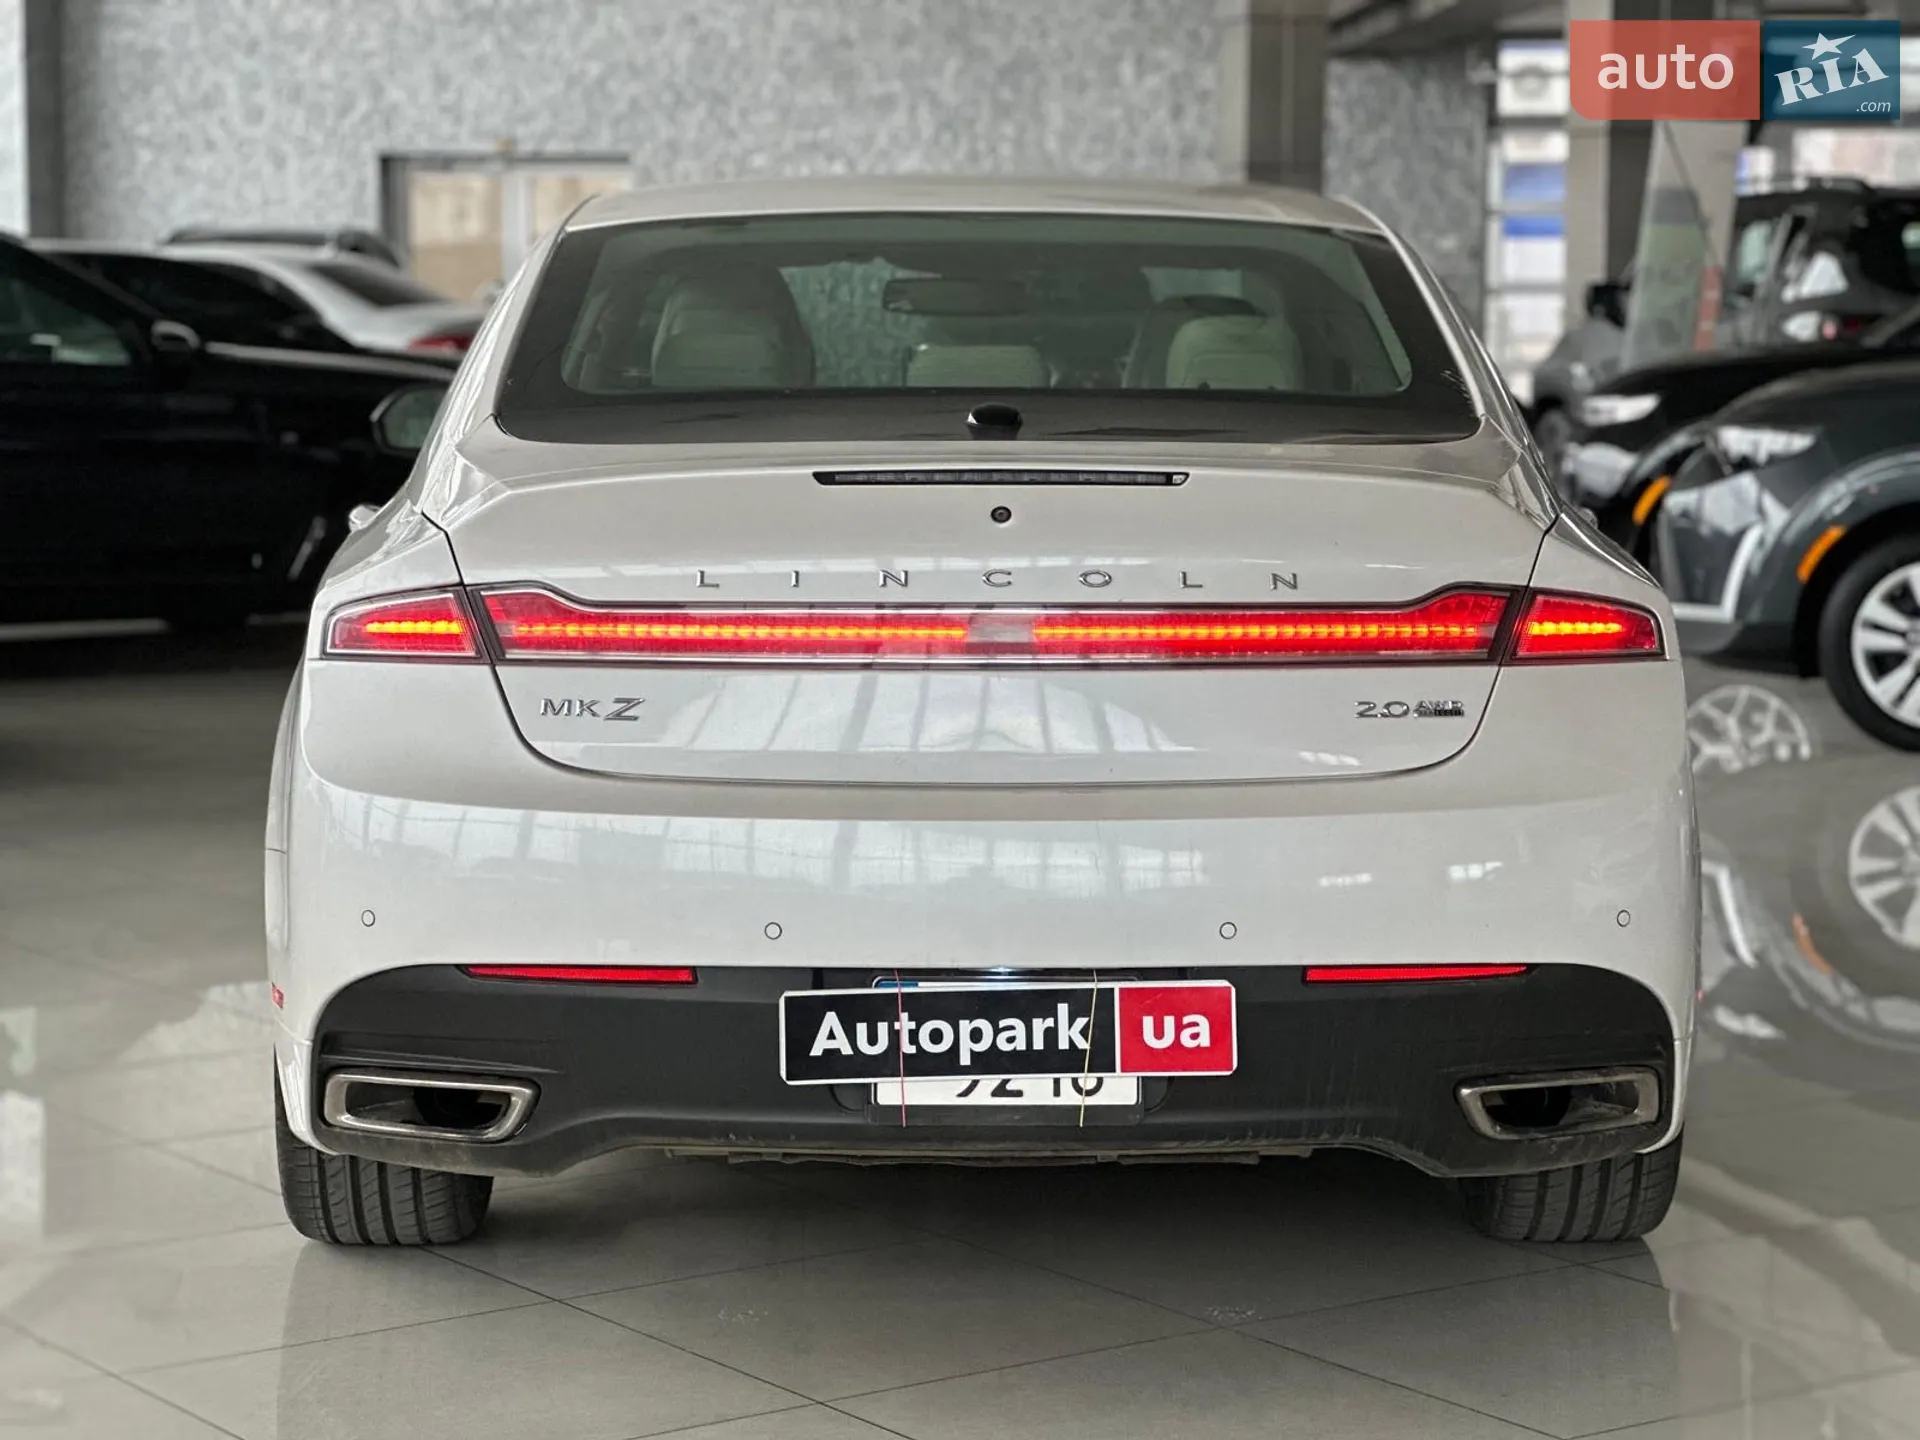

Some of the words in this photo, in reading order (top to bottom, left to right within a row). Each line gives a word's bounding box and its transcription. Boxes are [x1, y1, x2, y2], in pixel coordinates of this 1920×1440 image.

[695, 568, 1299, 590] LINCOLN
[540, 697, 646, 721] MKZ
[1354, 700, 1411, 719] 2.0
[808, 1002, 1093, 1066] Autopark
[1141, 1012, 1211, 1050] ua
